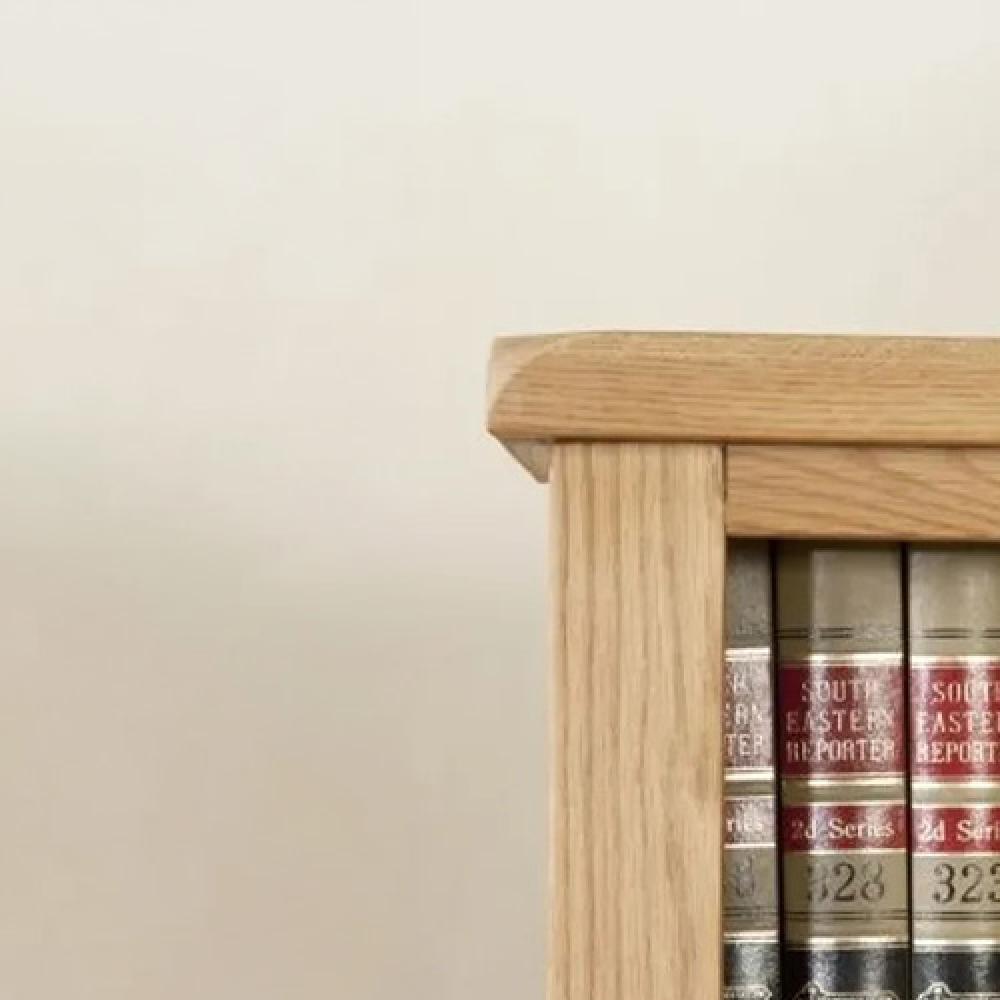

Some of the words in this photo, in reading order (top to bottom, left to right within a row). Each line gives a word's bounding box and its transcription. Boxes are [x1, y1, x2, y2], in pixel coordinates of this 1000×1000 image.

[801, 680, 879, 702] SOUTH
[786, 710, 895, 733] EASTERN
[786, 740, 895, 762] REPORTER
[791, 818, 816, 839] 2d
[829, 818, 895, 839] Series
[920, 819, 945, 841] 2d
